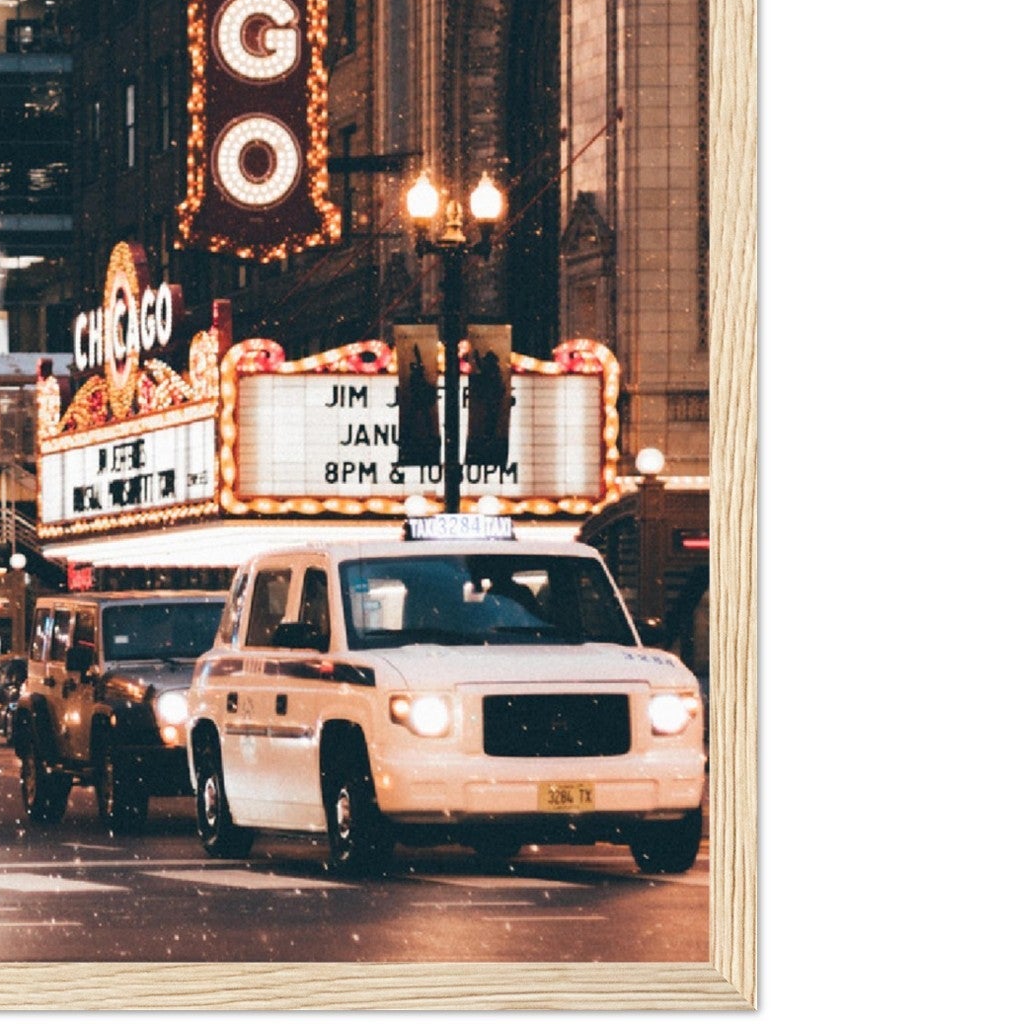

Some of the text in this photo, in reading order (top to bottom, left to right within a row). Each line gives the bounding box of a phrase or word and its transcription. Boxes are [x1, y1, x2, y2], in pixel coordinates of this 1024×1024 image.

[73, 282, 173, 371] CHICAGO
[324, 384, 368, 409] JIM
[324, 461, 378, 485] 8PM
[437, 515, 482, 537] 3284
